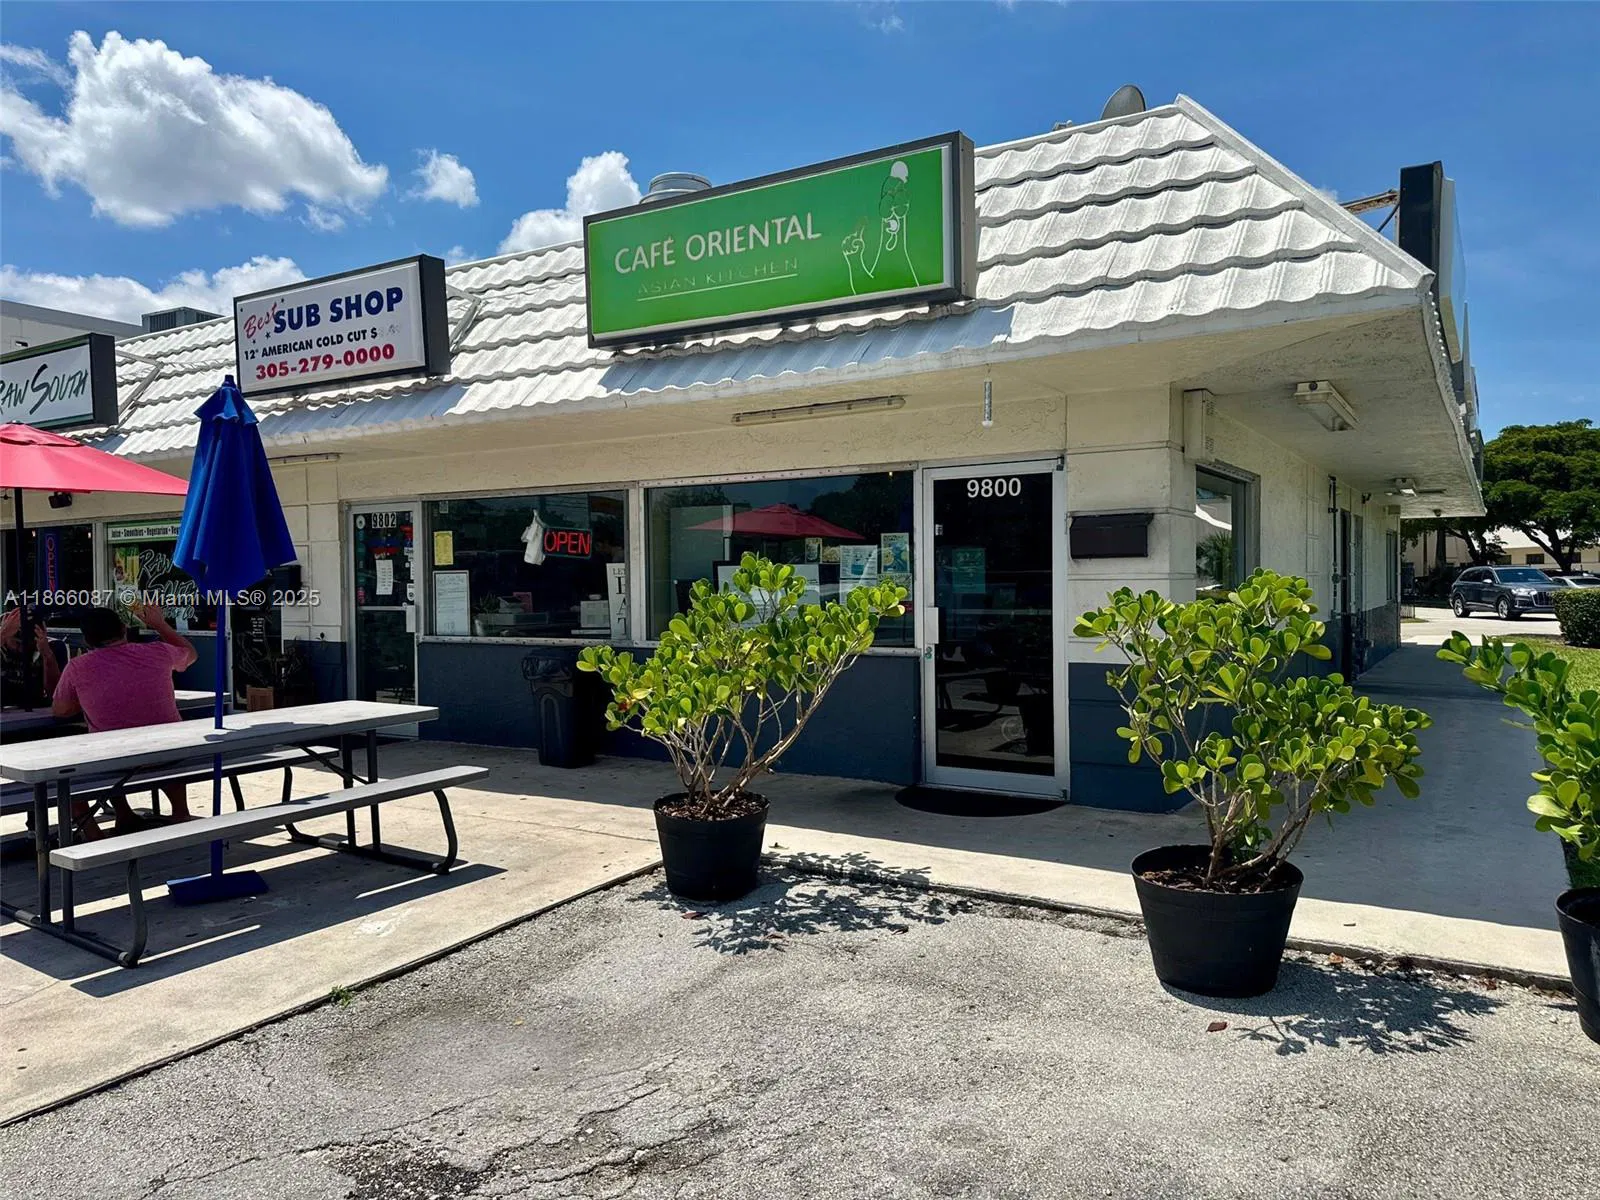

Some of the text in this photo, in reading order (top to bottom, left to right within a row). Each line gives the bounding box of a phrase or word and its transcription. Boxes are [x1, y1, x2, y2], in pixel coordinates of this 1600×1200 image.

[614, 212, 822, 274] CAFÉ ORIENTAL
[638, 257, 798, 295] ASIAN KITCHEN
[243, 286, 403, 339] Best SUB SHOP
[262, 338, 313, 358] AMERICAN
[316, 336, 344, 348] COLD
[349, 330, 369, 342] CUT
[256, 343, 395, 380] 305-279-0000
[967, 478, 1021, 498] 9800
[372, 512, 397, 528] 9802
[543, 531, 591, 555] OPEN
